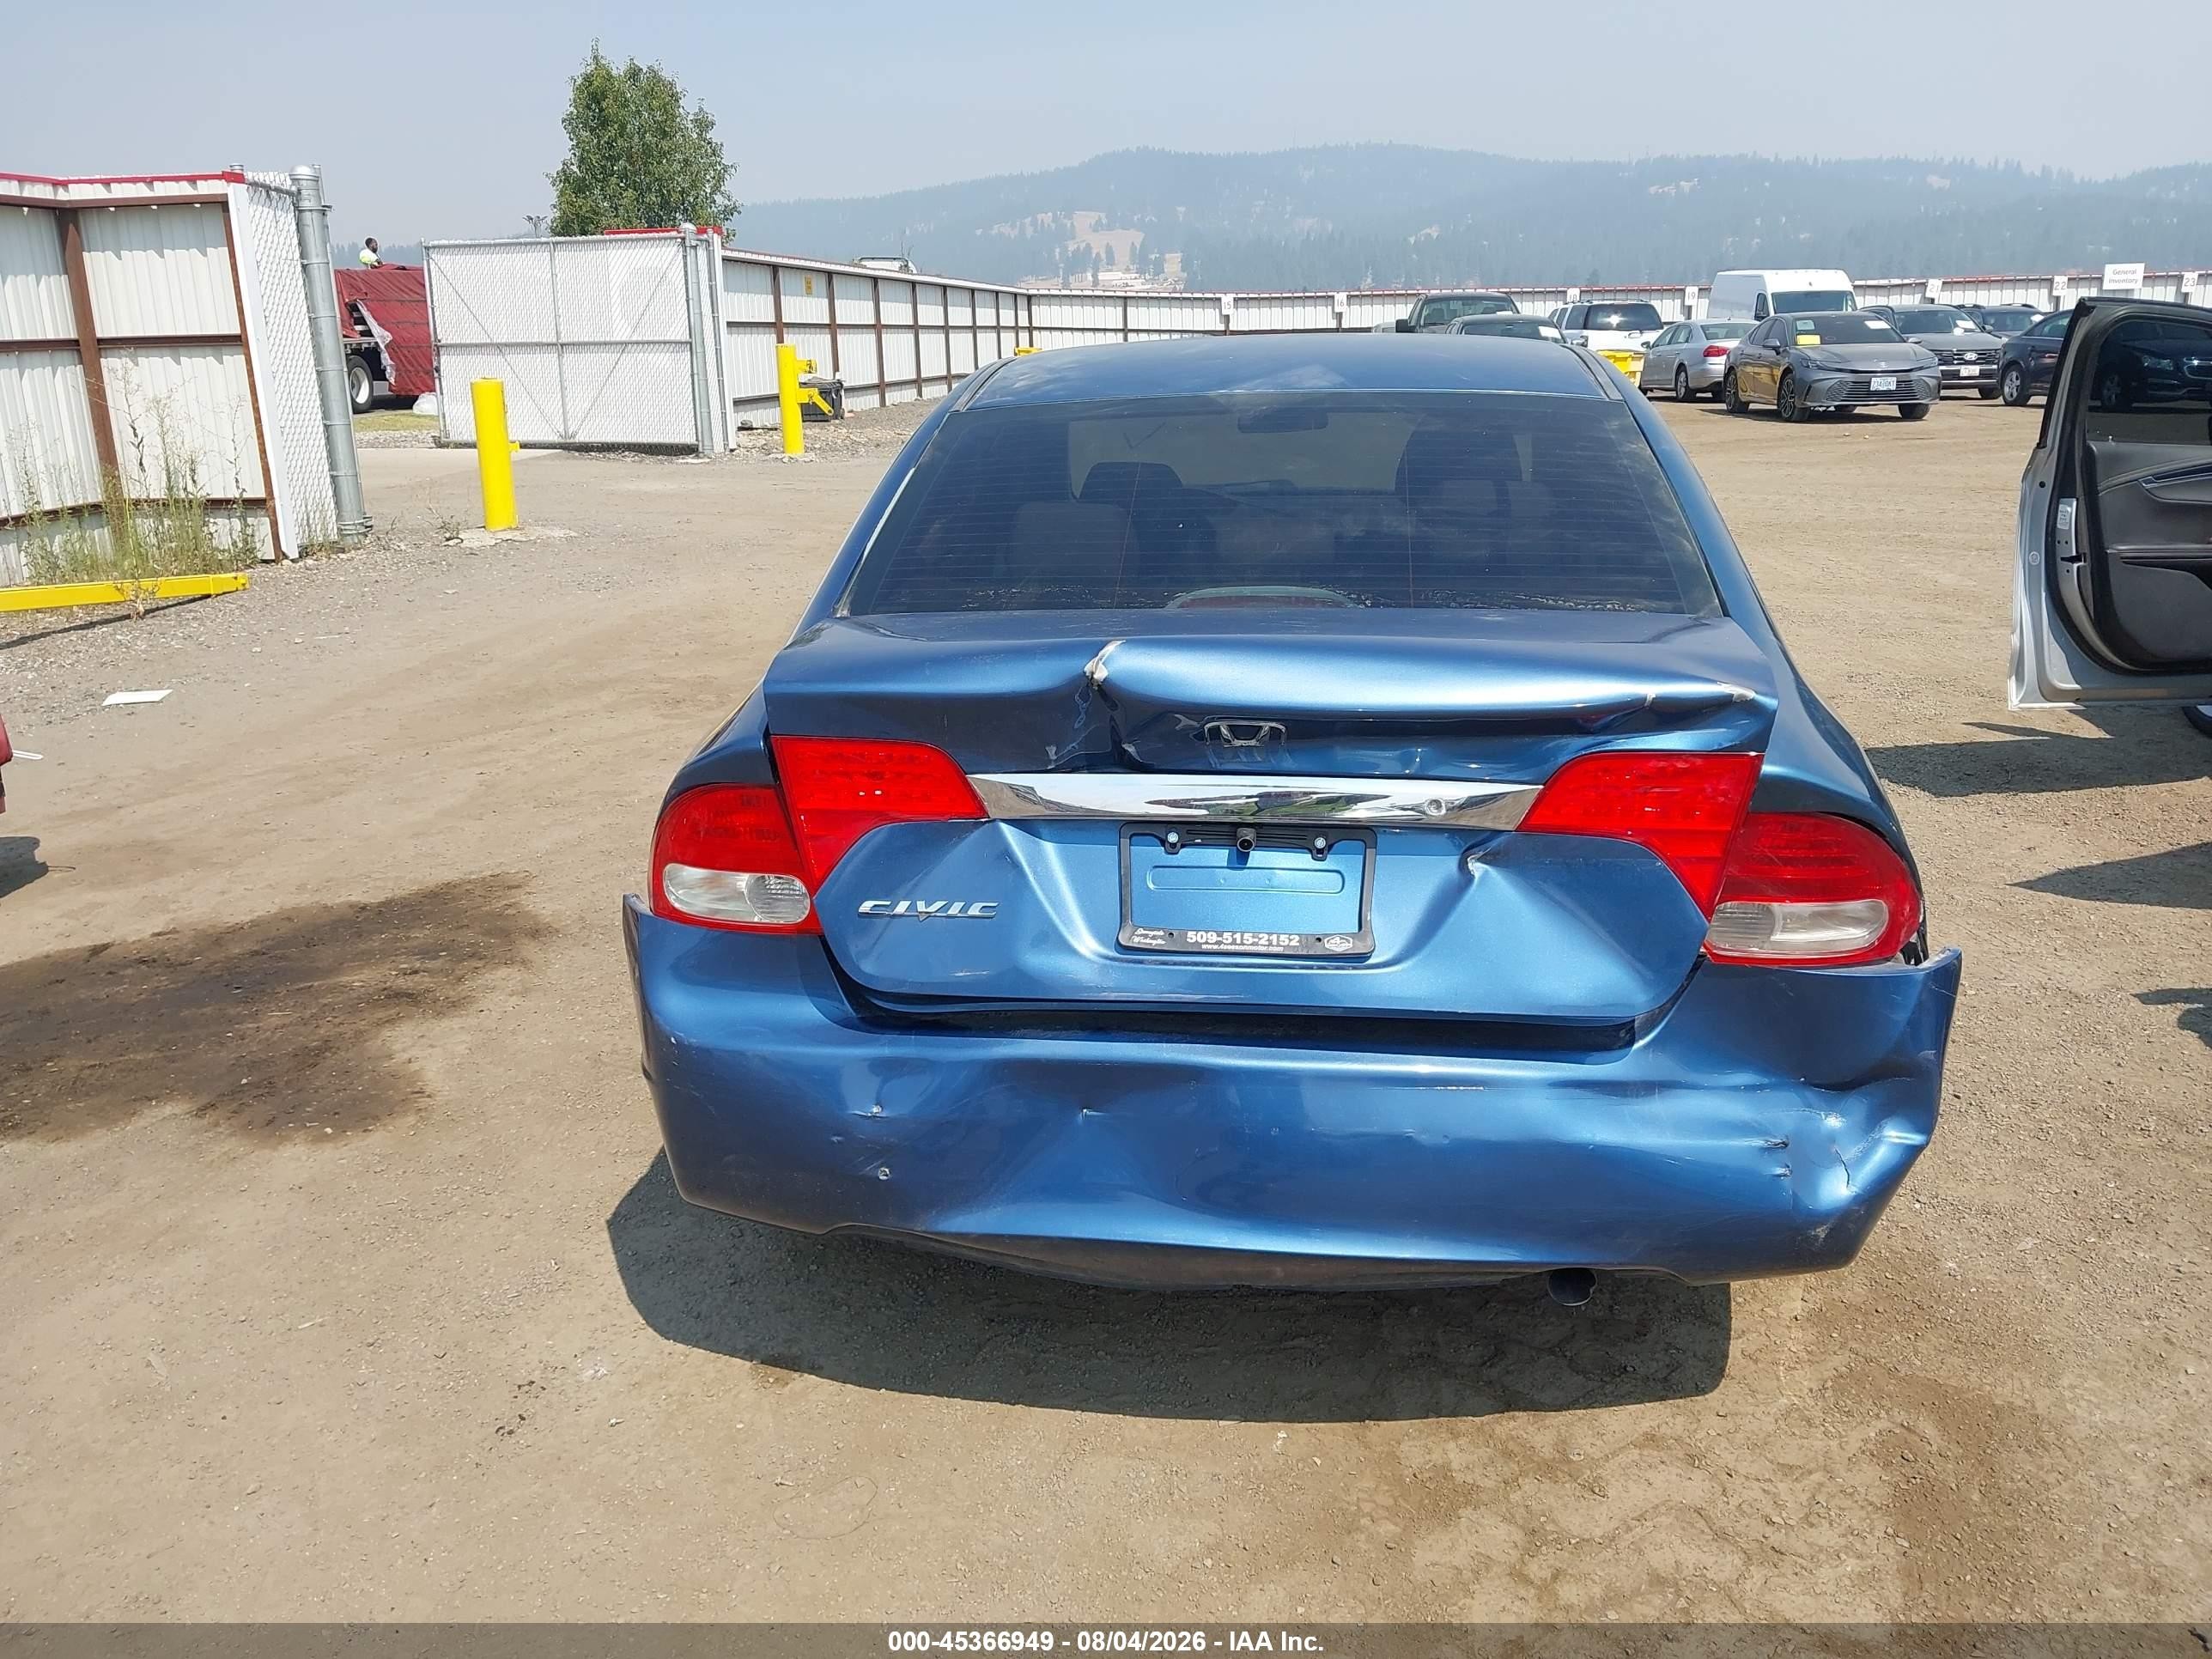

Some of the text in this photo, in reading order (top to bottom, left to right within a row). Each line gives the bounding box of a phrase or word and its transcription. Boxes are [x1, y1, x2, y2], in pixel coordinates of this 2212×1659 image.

[2054, 281, 2067, 291] 22
[2184, 277, 2196, 287] 23
[1929, 283, 1940, 294] 21
[1224, 301, 1232, 310] 15
[858, 900, 1000, 921] CIVIC
[1186, 931, 1300, 946] 509-515-2152
